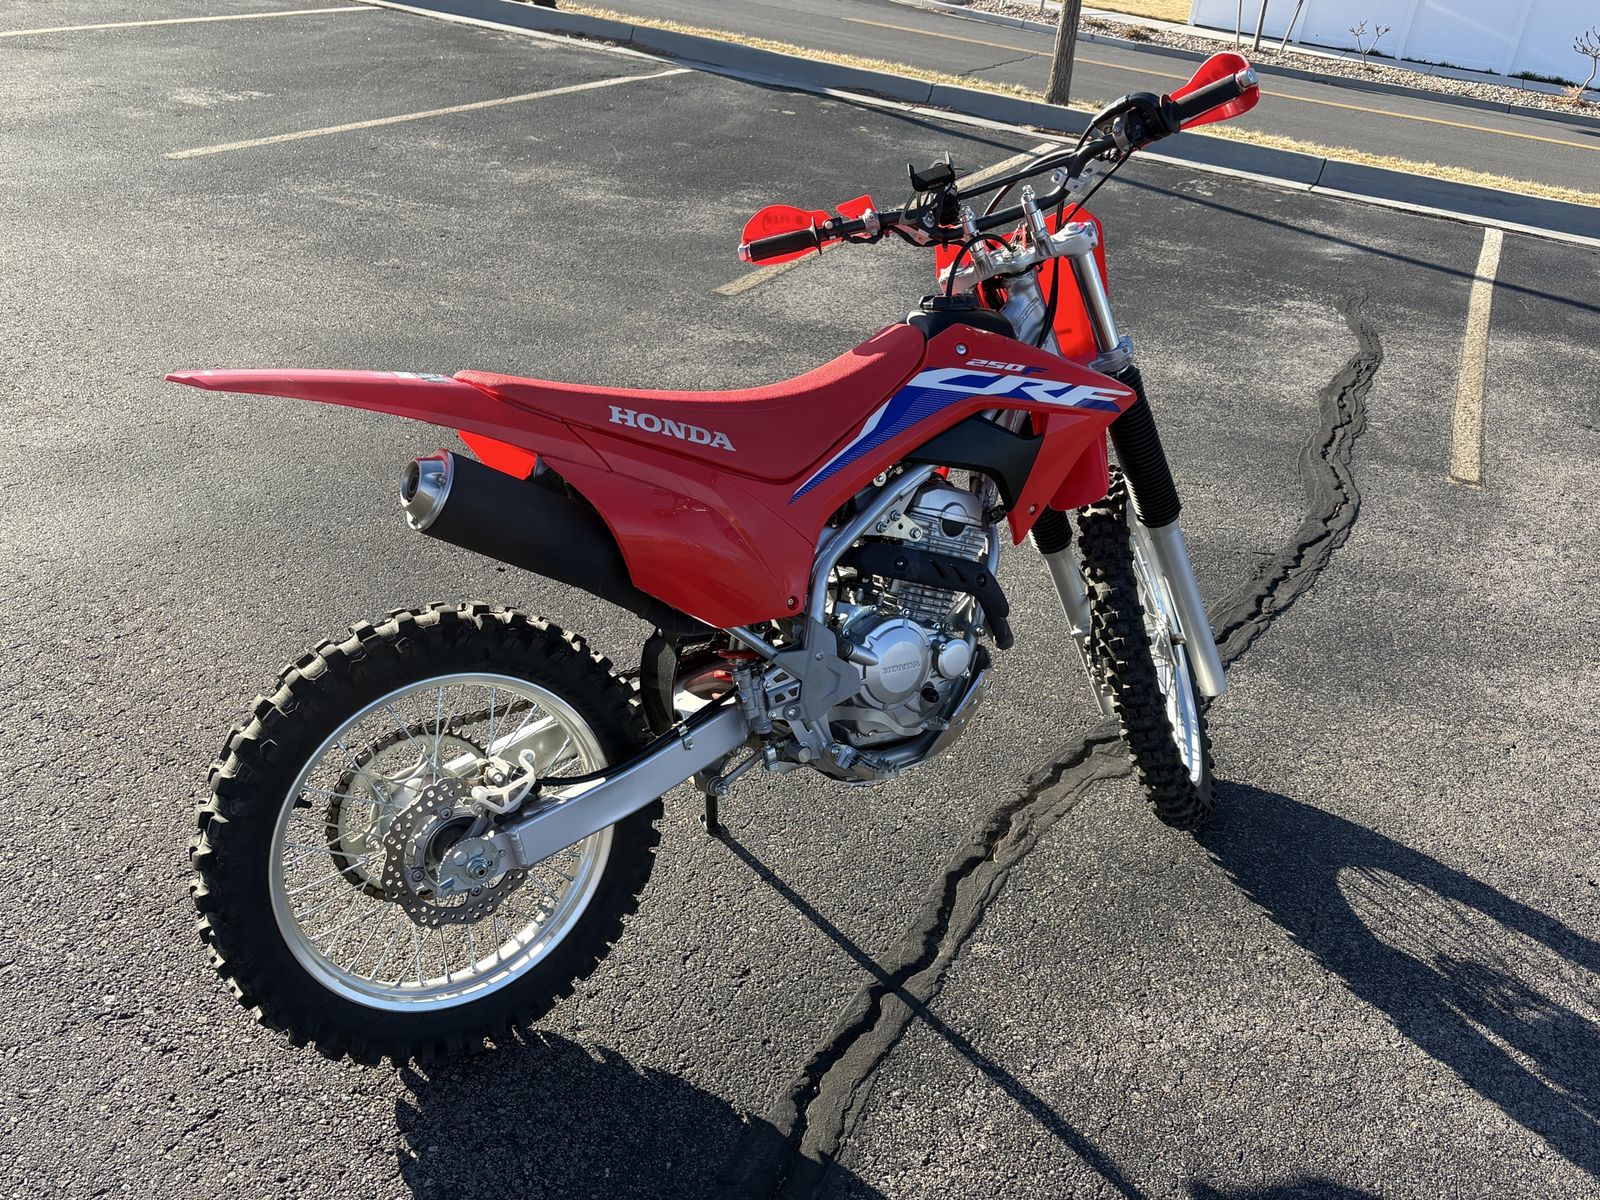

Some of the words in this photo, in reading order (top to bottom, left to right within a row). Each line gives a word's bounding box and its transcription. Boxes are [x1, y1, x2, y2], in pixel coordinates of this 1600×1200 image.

[966, 358, 1049, 375] 250F
[906, 367, 1133, 407] CRF
[608, 404, 737, 452] HONDA
[881, 660, 921, 675] HONDA
